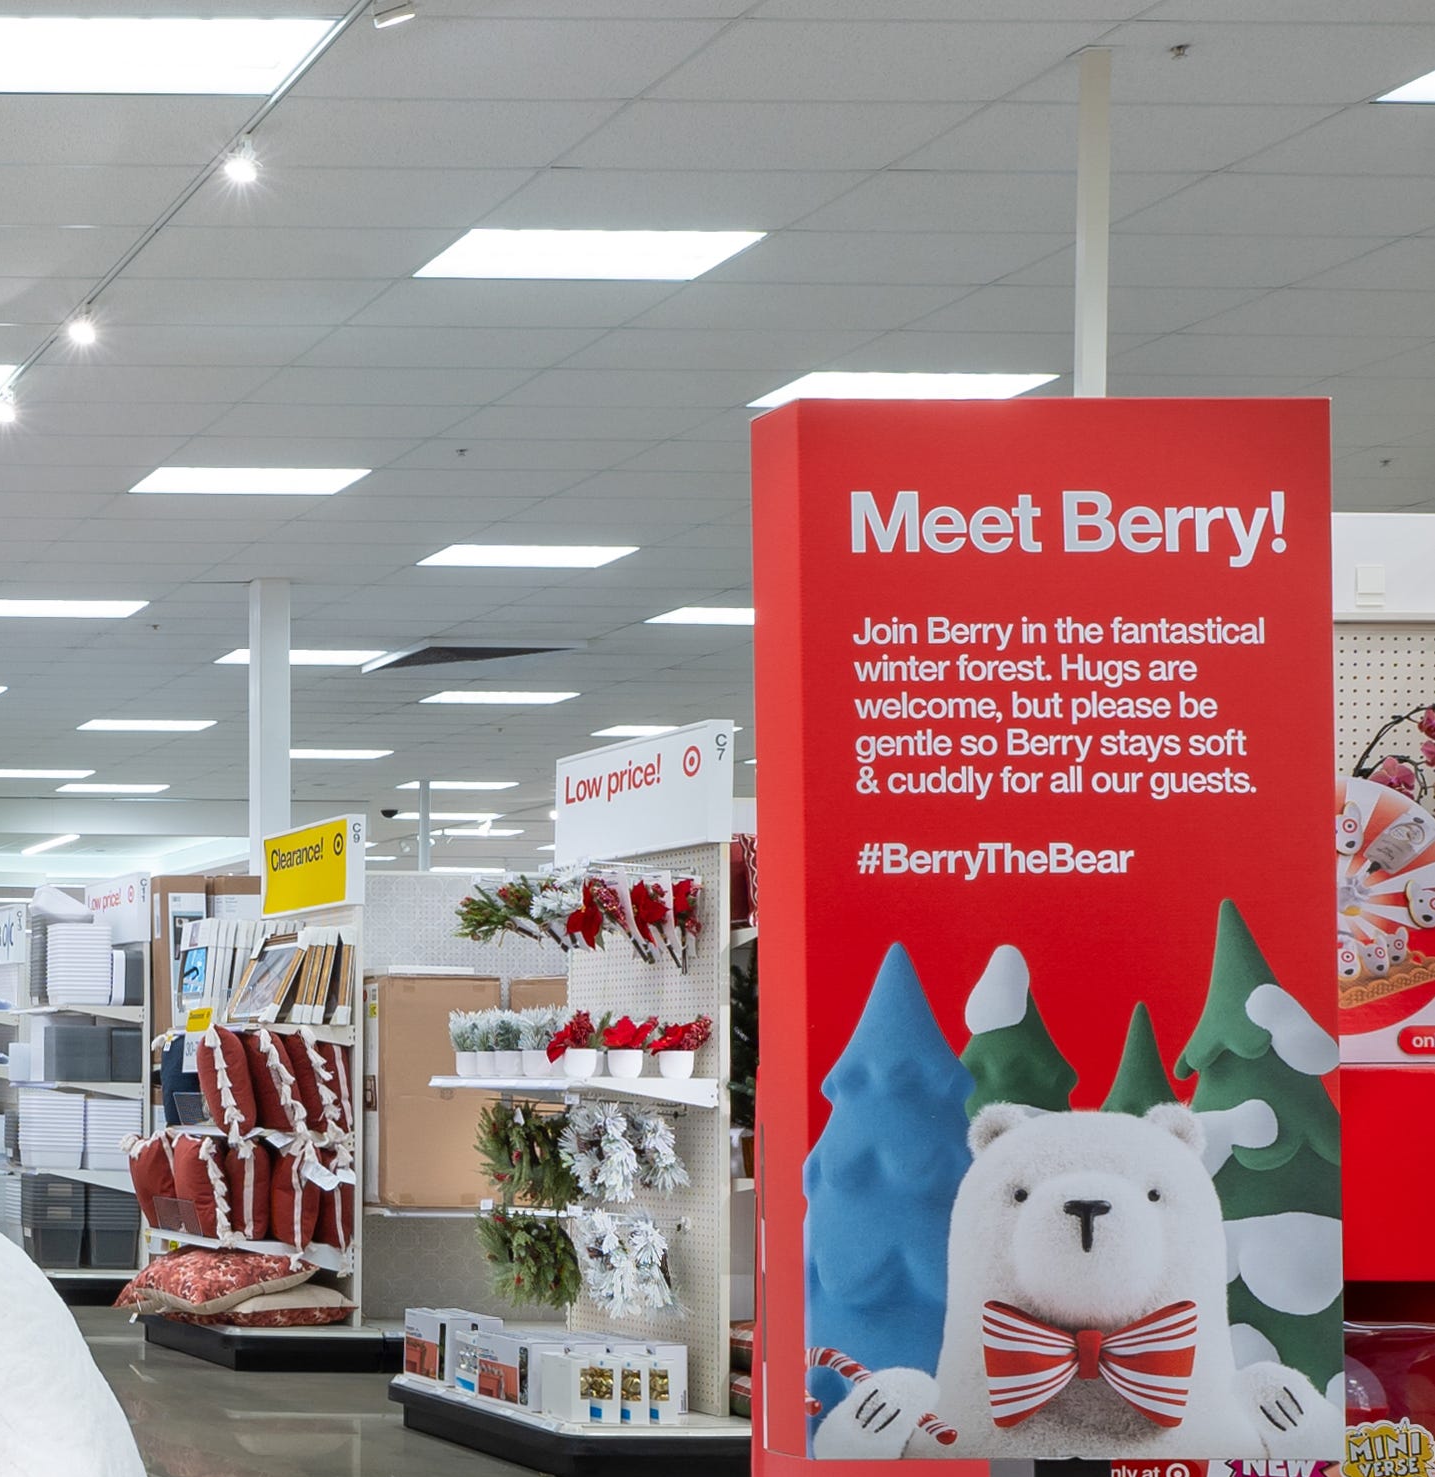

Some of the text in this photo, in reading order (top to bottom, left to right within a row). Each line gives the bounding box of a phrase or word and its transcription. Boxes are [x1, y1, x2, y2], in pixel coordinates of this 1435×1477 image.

[850, 491, 1286, 567] Meet Berry!
[853, 616, 1266, 651] Join Berry in the fantastical
[854, 654, 1197, 688] winter forest. Hugs are
[855, 691, 1218, 724] welcome, but please be
[856, 728, 1247, 763] gentle so Berry stays soft
[565, 753, 661, 805] Low price!
[856, 766, 1257, 800] & cuddly for all our guests.
[271, 837, 324, 872] Clearance!
[858, 843, 1134, 880] #BerryTheBear
[87, 889, 121, 912] Low price!
[1348, 1432, 1422, 1463] MINI
